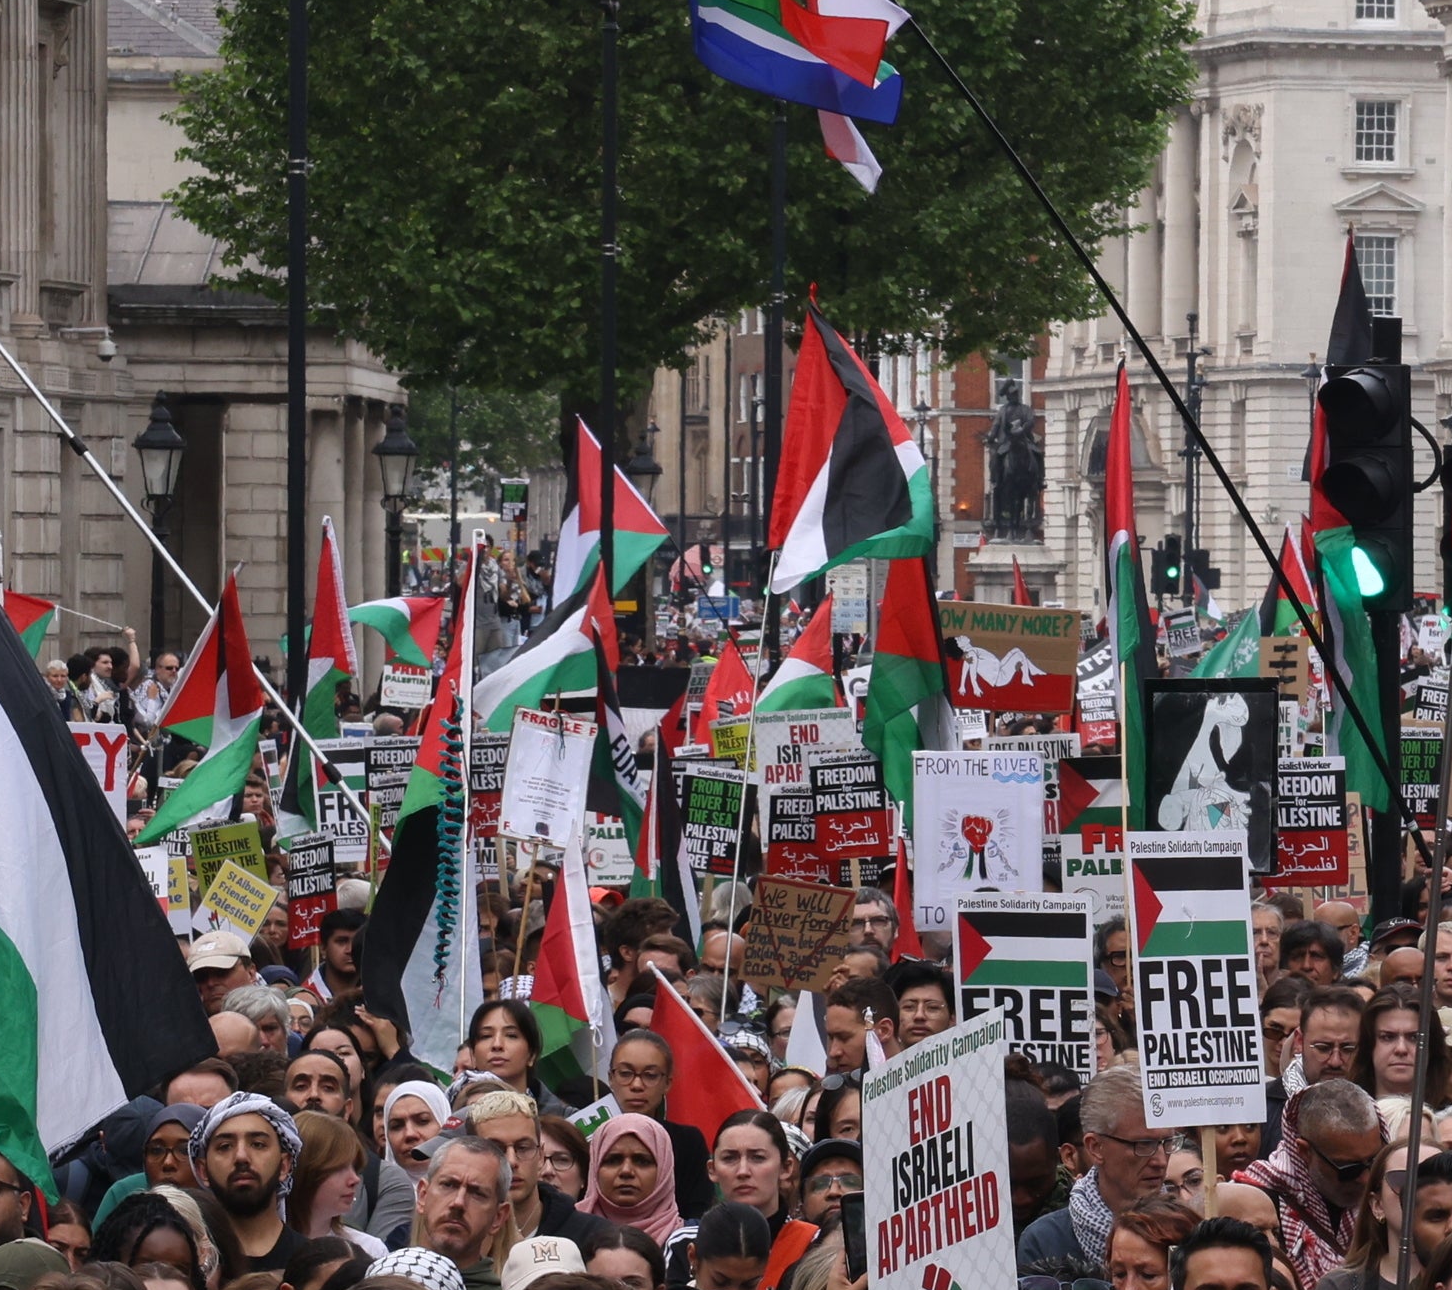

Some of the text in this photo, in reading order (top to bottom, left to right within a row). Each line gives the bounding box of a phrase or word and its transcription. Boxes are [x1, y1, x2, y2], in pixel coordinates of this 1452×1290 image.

[971, 612, 1074, 637] MANY MORE?
[1081, 698, 1113, 710] FREEDOM
[1081, 710, 1116, 722] PALESTINE
[716, 727, 734, 738] FREE
[789, 724, 820, 744] END
[1425, 741, 1441, 753] THE
[916, 758, 1039, 777] FROM THE RIVER
[1307, 761, 1332, 770] Worker
[1423, 756, 1436, 768] TO
[817, 765, 876, 786] FREEDOM
[1413, 770, 1431, 783] SEA
[692, 779, 722, 796] FROM
[689, 794, 739, 812] RIVER TO
[816, 790, 881, 811] PALESTINE
[1294, 797, 1308, 807] for
[688, 810, 732, 827] THE SEA
[829, 816, 872, 832] الحرية
[196, 830, 219, 845] FREE
[825, 831, 879, 851] لفلسطين
[1130, 839, 1242, 854] Palestine Solidarity Campaign
[199, 838, 251, 856] PALESTINE
[712, 842, 727, 857] BE
[240, 854, 259, 867] THE
[290, 847, 329, 870] FREEDOM
[219, 881, 250, 906] Friends
[236, 877, 266, 900] Albans
[289, 874, 333, 897] PALESTINE
[210, 892, 256, 927] Palestine
[957, 898, 1086, 912] Palestine Solidarity Campaign
[920, 906, 945, 924] TO
[1138, 958, 1254, 1031] FREE
[962, 988, 1090, 1042] FREE
[1145, 1030, 1258, 1066] PALESTINE
[864, 1019, 1003, 1103] Palestine Solidarity Campaign
[1149, 1068, 1258, 1087] END ISRAELI OCCUPATION
[908, 1074, 952, 1145] END
[1167, 1094, 1244, 1109] www.palestinecampaign.org
[892, 1121, 974, 1212] ISRAELI
[878, 1171, 999, 1279] APARTHEID
[531, 1241, 560, 1263] M
